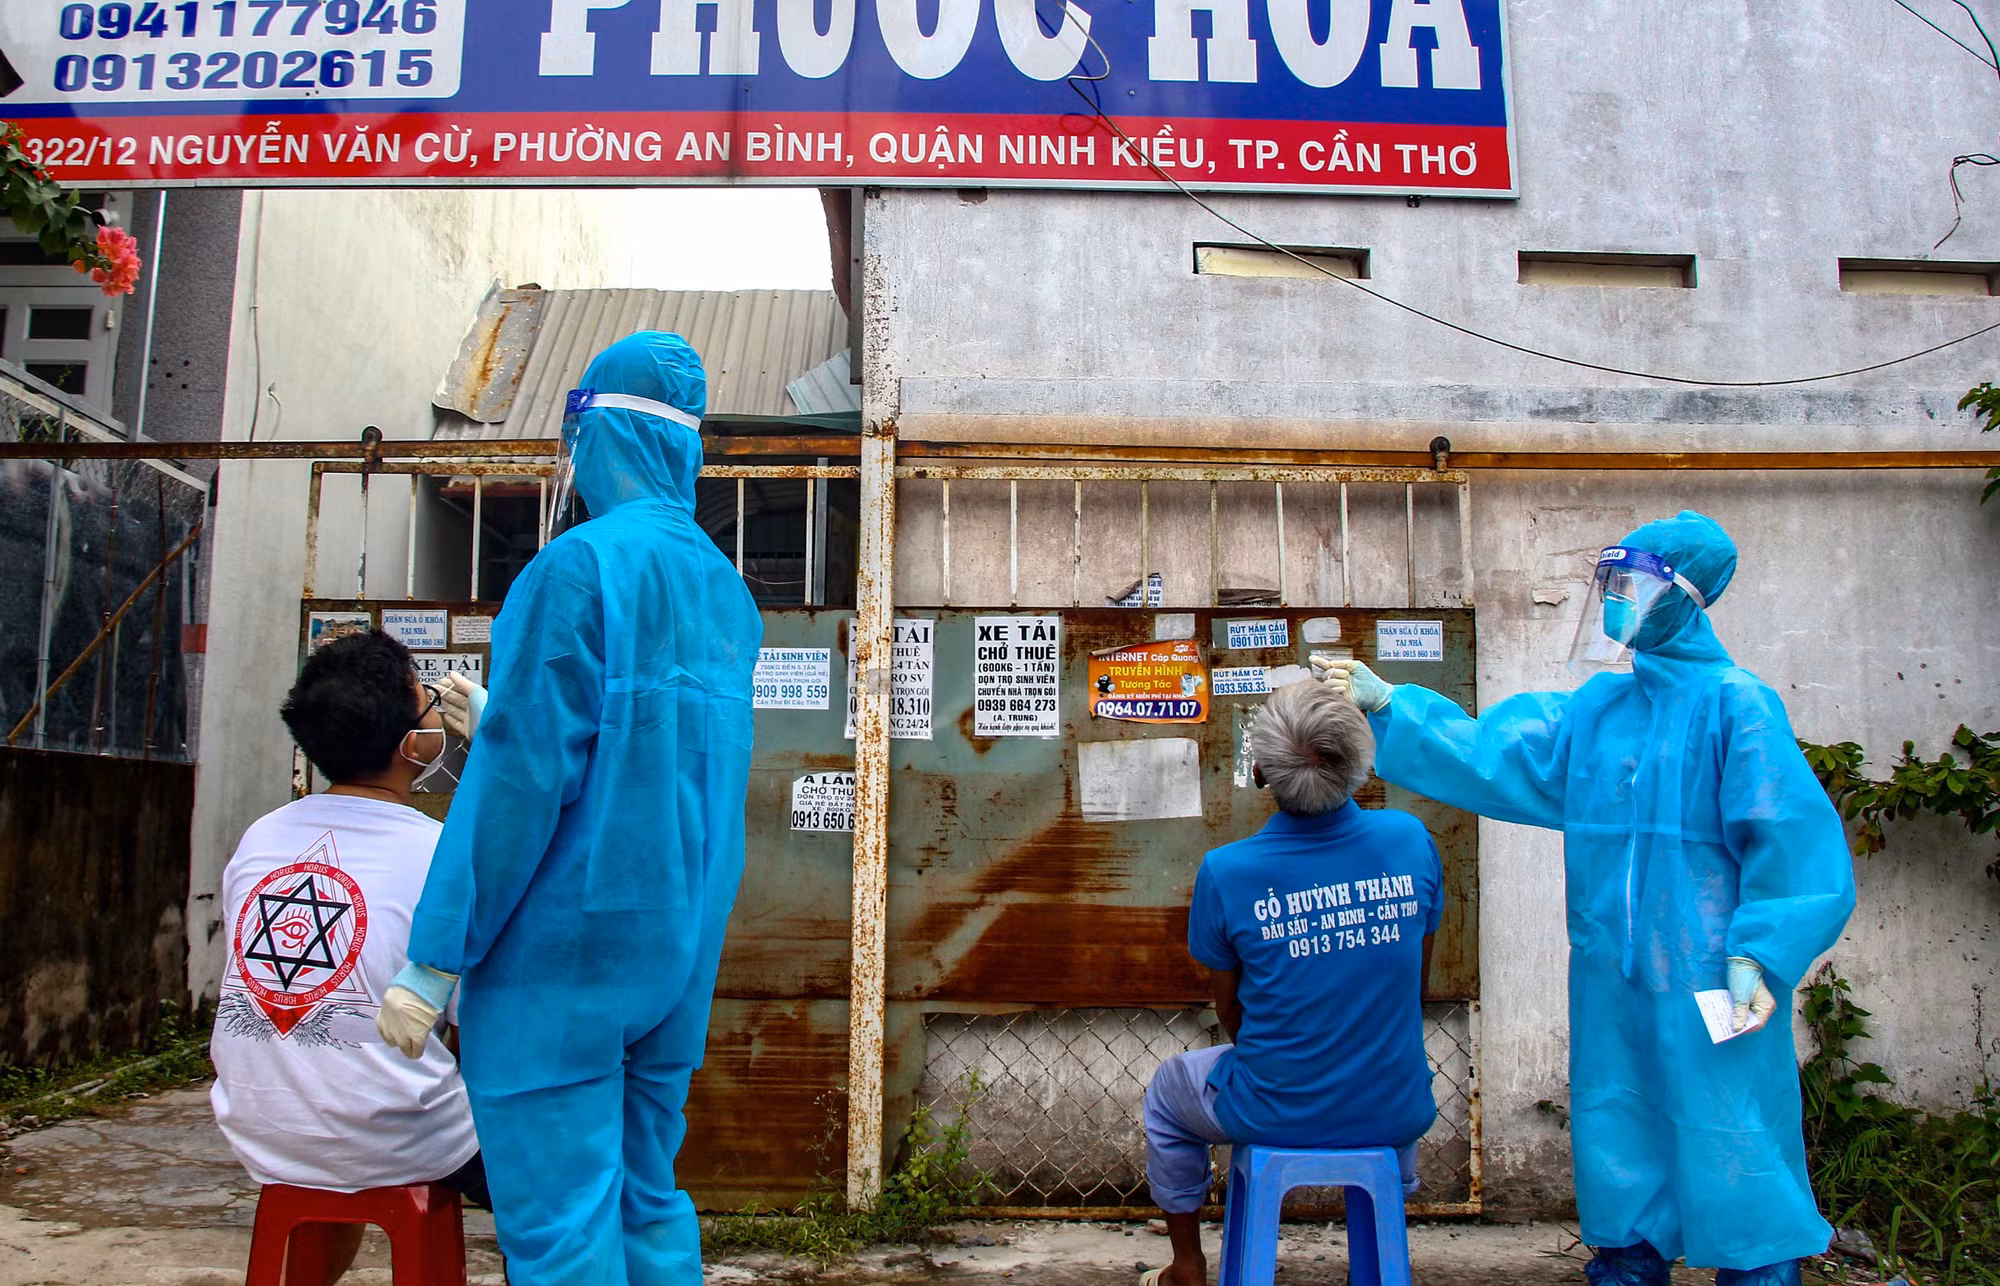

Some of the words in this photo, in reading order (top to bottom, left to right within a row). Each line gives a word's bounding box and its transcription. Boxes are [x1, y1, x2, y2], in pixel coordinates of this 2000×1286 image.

[59, 0, 437, 40] 0941177946
[53, 49, 434, 91] 0913202615
[26, 136, 137, 166] 322/12
[149, 120, 309, 164] NGUYỄN
[323, 126, 401, 163] VĂN
[414, 124, 478, 167] CỪ,
[493, 124, 662, 162] PHƯỜNG
[675, 131, 731, 162] AN
[745, 124, 854, 168] BÌNH,
[868, 125, 983, 170] QUẬN
[1000, 135, 1095, 166] NINH
[1112, 124, 1215, 174] KIỀU,
[1228, 139, 1285, 170] TP.
[1299, 129, 1381, 173] CẦN
[1394, 141, 1477, 176] THƠ
[892, 622, 930, 643] TẢI
[978, 625, 1008, 641] XE
[1018, 619, 1056, 641] TẢI
[1231, 636, 1251, 648] 0901
[1253, 635, 1267, 646] 011
[1269, 634, 1287, 646] 300
[763, 649, 780, 661] TẢI
[781, 652, 804, 661] SINH
[805, 650, 828, 661] VIÊN
[978, 642, 1009, 660] CHỞ
[1015, 644, 1056, 660] THUÊ
[443, 655, 481, 671] TẢI
[1098, 652, 1148, 662] INTERNET
[1151, 653, 1169, 662] Cáp
[1171, 653, 1199, 664] Quang
[978, 662, 1013, 673] (600KG
[1023, 662, 1028, 672] 1
[1154, 664, 1183, 676] HÌNH
[910, 673, 926, 682] SV
[978, 675, 995, 686] DỌN
[997, 675, 1013, 686] TRỌ
[1015, 675, 1034, 684] SINH
[1036, 673, 1055, 684] VIÊN
[1120, 680, 1151, 690] Tương
[1153, 679, 1172, 689] Tác
[1215, 681, 1271, 694] 0933.563.33
[781, 685, 802, 698] 998
[806, 685, 828, 698] 559
[896, 687, 915, 697] TRỌN
[916, 686, 930, 695] GÓI
[1007, 686, 1022, 696] NHÀ
[1024, 687, 1042, 698] TRỌN
[1043, 686, 1056, 696] GÓI
[978, 699, 1006, 711] 0939
[1009, 699, 1031, 711] 664
[1034, 699, 1056, 711] 273
[1097, 702, 1197, 717] 0964.07.71.07
[906, 718, 929, 729] 24/24
[831, 788, 856, 796] THU
[792, 810, 820, 828] 0913
[823, 812, 845, 829] 650
[1254, 887, 1282, 921] GỖ
[1285, 883, 1351, 915] HUỲNH
[1355, 872, 1414, 902] THÀNH
[1261, 918, 1285, 940] ĐẦU
[1287, 914, 1308, 936] SẤU
[1321, 913, 1336, 930] AN
[1337, 907, 1366, 927] BÌNH
[1377, 899, 1398, 920] CẦN
[1289, 934, 1331, 958] 0913
[1335, 928, 1366, 950] 754
[1371, 923, 1400, 945] 344
